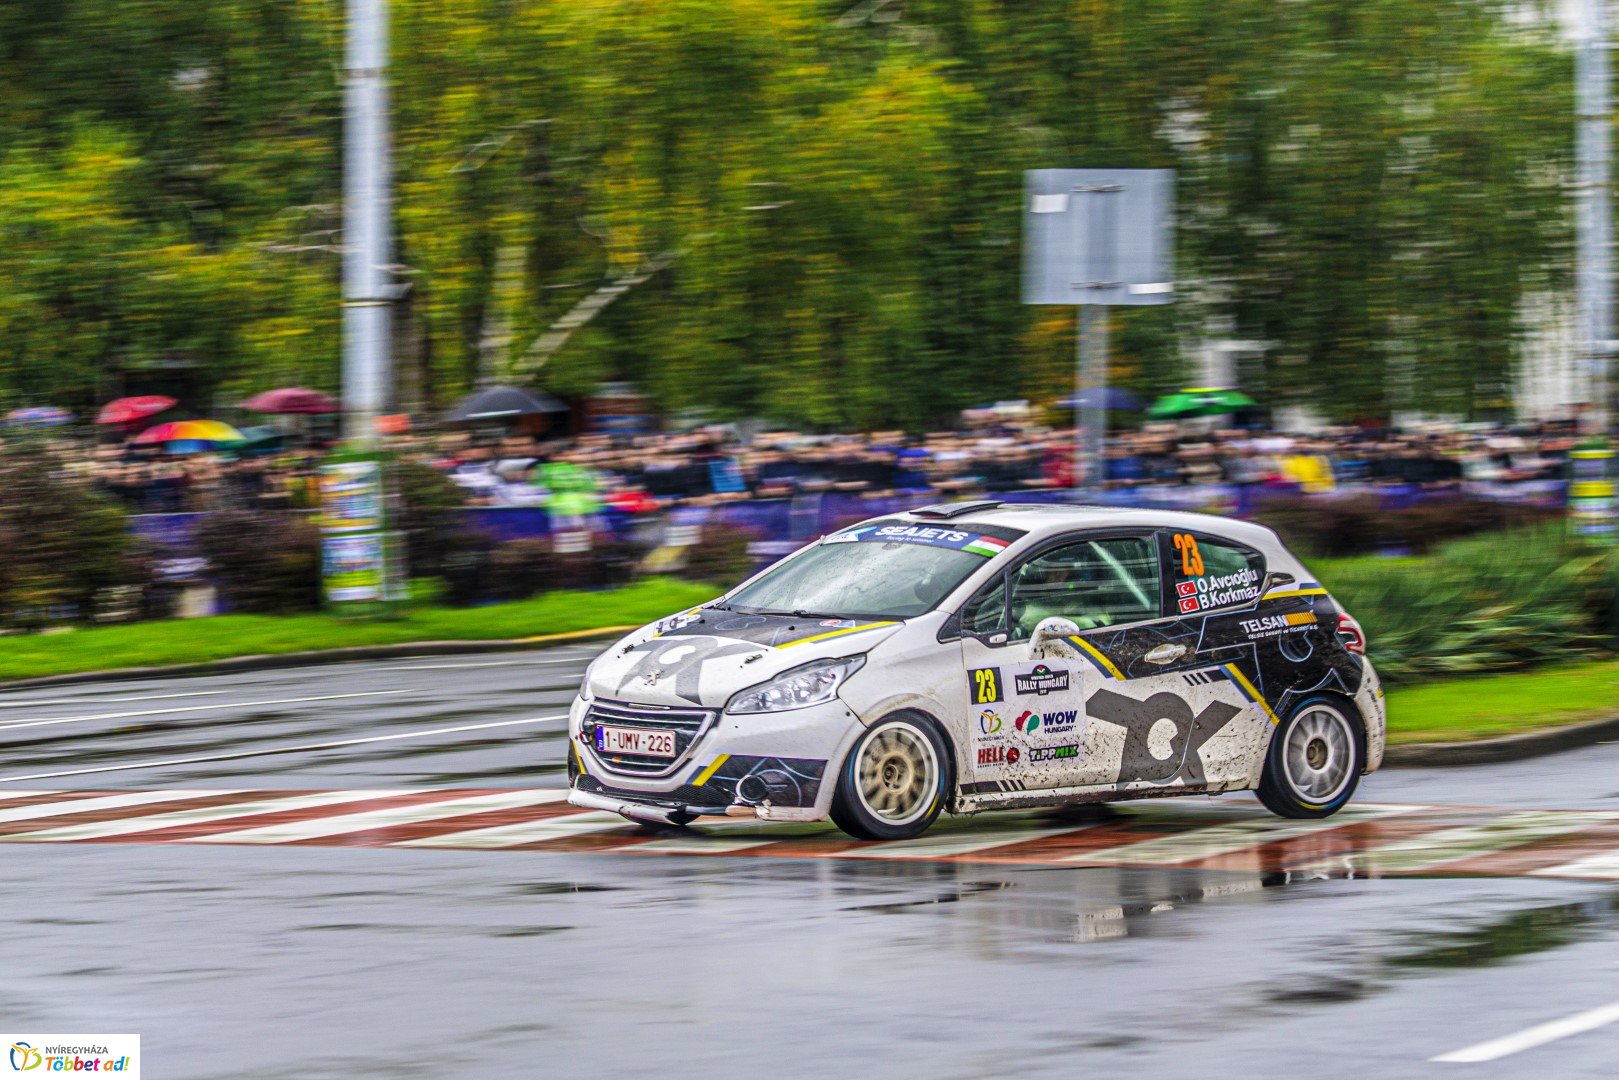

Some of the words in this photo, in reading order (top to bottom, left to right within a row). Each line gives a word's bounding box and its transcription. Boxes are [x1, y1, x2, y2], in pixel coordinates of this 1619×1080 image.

[875, 526, 968, 542] SEAJETS
[1173, 533, 1205, 576] 23
[1199, 586, 1261, 609] B.Korkmaz
[1239, 614, 1288, 633] TELSAN
[975, 669, 997, 703] 23
[1017, 679, 1037, 691] RALLY
[1039, 674, 1068, 689] HUNGARY
[1043, 711, 1077, 726] WOW
[1044, 725, 1074, 734] HUNGARY
[605, 731, 672, 752] 1-UMV-226
[978, 747, 1004, 764] HELL
